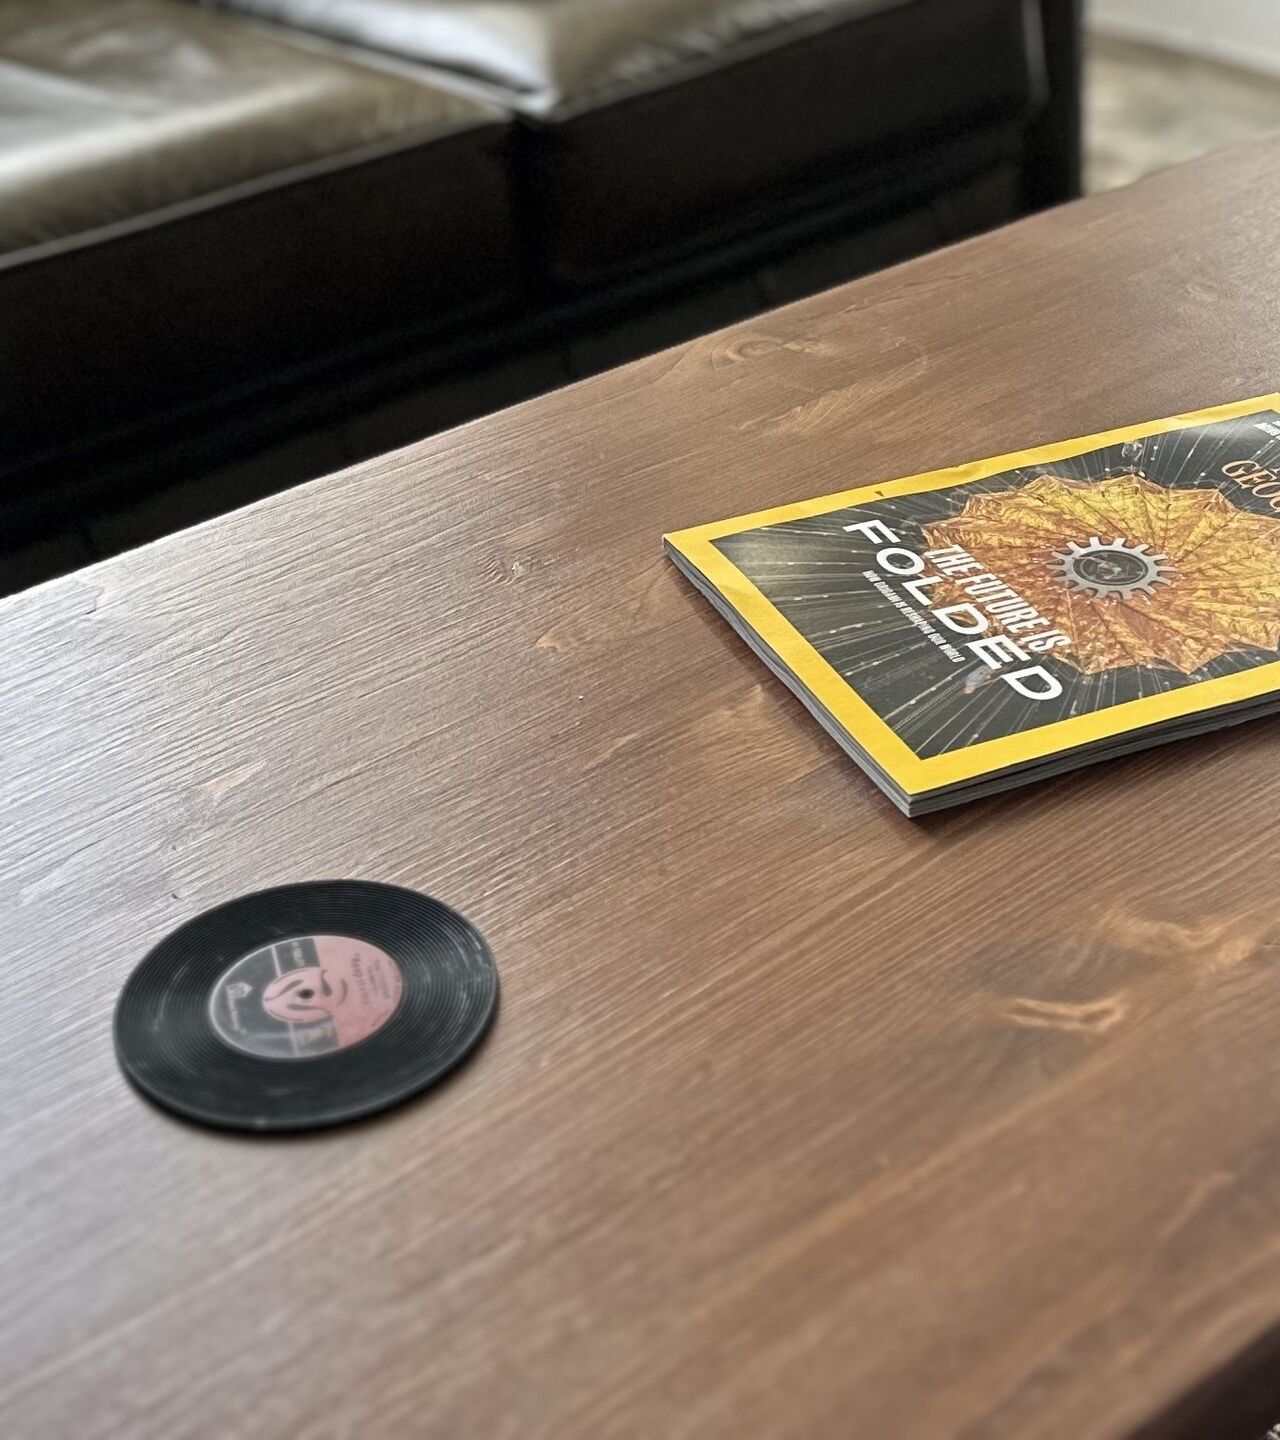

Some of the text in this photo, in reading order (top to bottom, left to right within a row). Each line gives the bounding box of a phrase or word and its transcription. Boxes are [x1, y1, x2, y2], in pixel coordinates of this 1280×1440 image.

[842, 519, 1062, 700] FOLDED
[900, 605, 936, 635] RESHAPING
[938, 643, 966, 663] WORLD
[922, 544, 1072, 652] THE FUTURE IS
